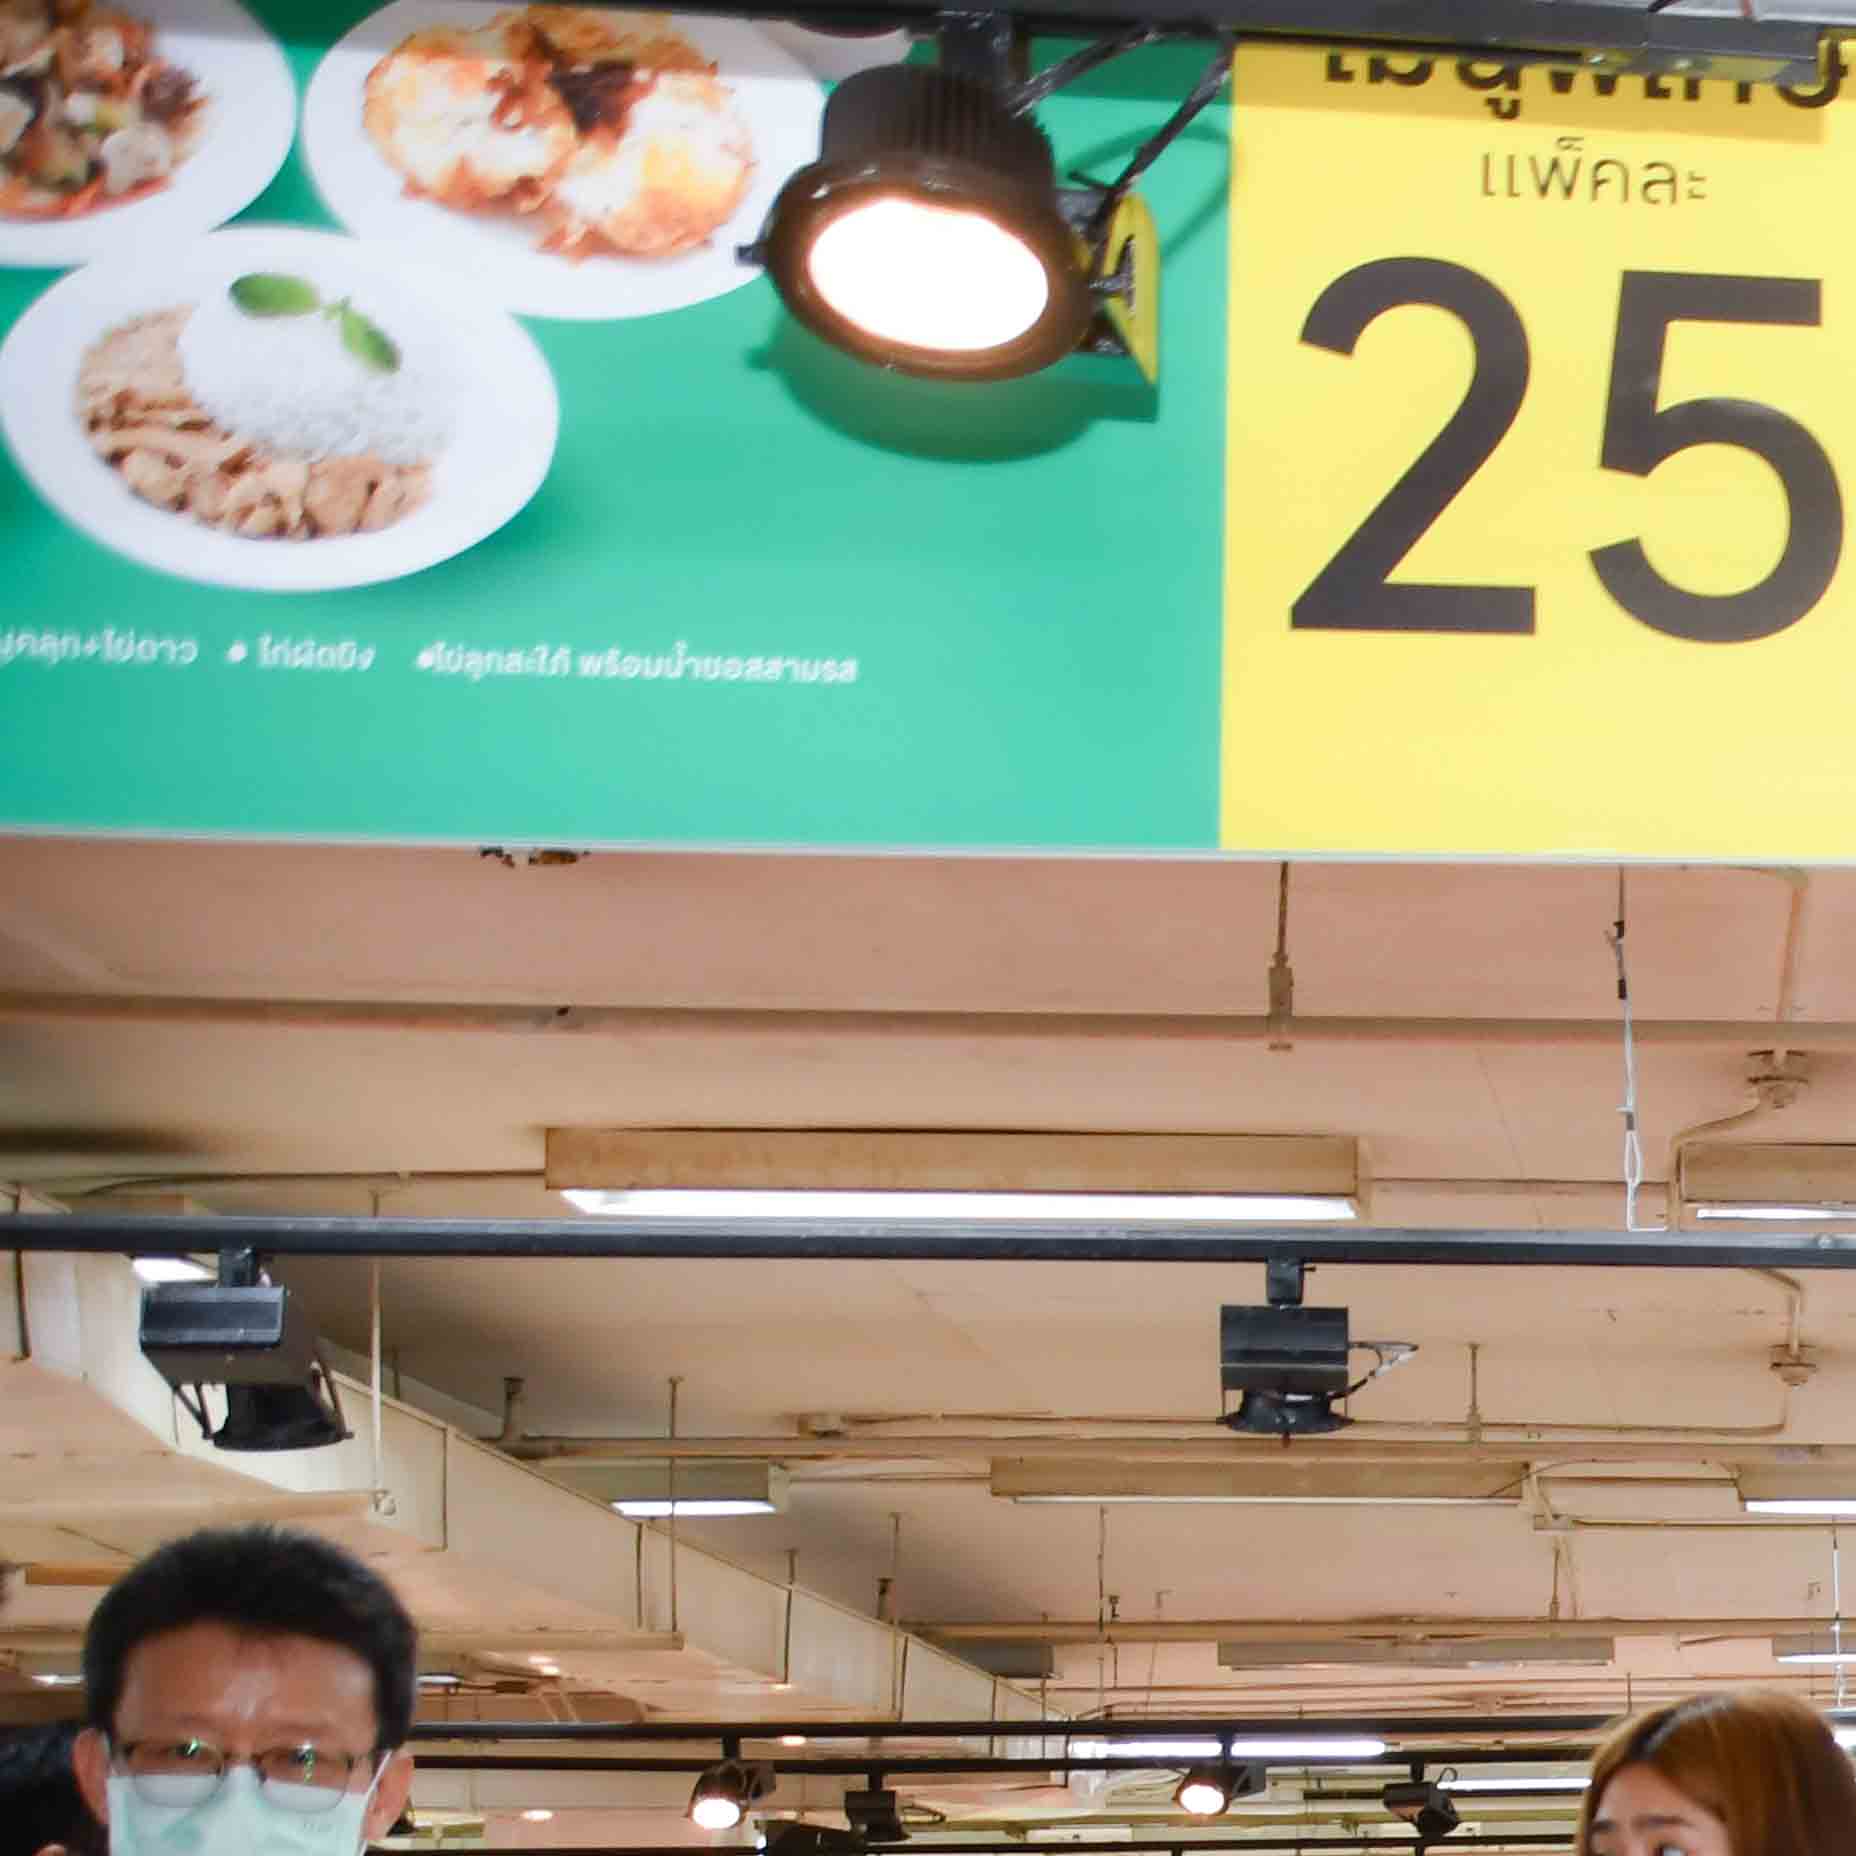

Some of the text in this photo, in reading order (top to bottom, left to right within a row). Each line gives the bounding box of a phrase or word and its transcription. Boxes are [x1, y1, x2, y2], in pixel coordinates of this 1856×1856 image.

[1481, 137, 1707, 205] แพ็คละ
[1290, 256, 1845, 644] 25
